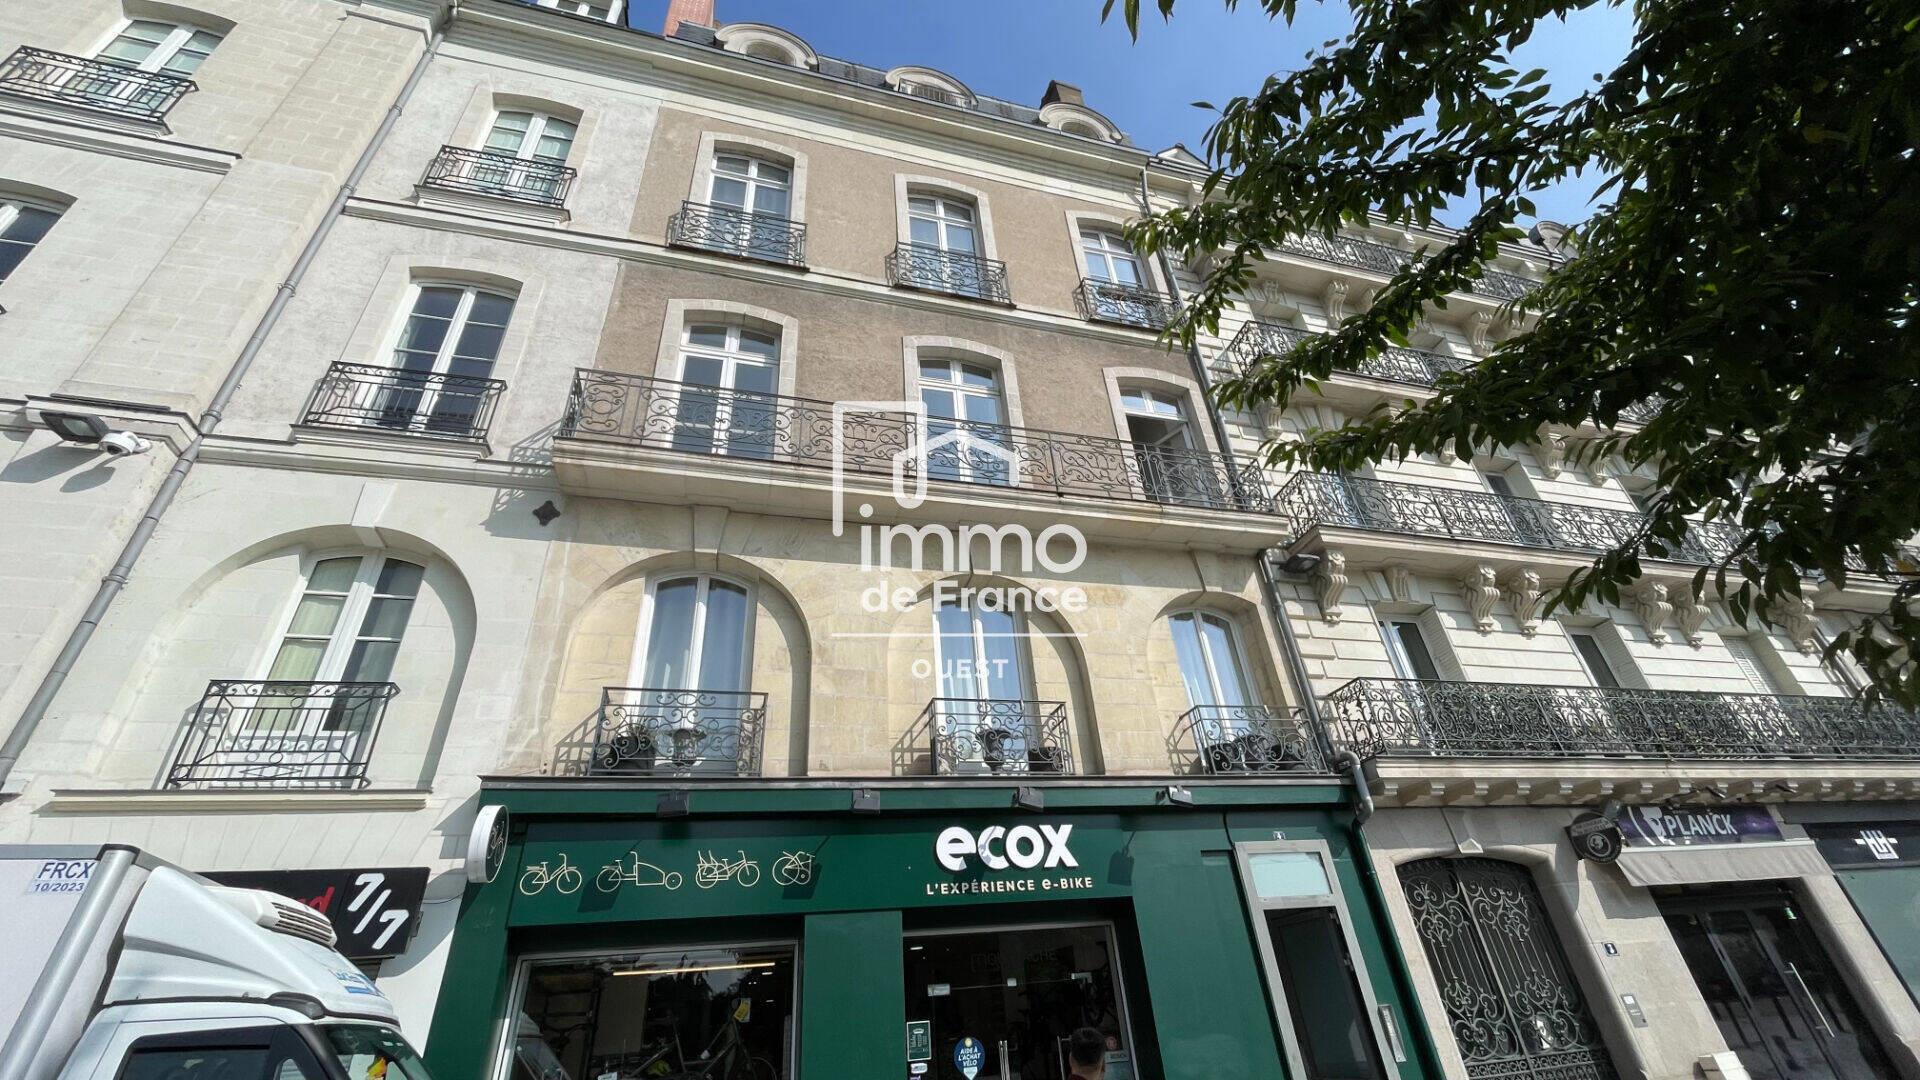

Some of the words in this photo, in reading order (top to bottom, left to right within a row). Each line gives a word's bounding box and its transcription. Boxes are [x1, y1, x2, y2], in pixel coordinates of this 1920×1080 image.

[1663, 813, 1738, 836] PLANCK
[37, 861, 97, 879] FRCX
[34, 882, 86, 892] 10/2023
[926, 878, 1036, 896] L'EXPÉRIENCE
[347, 872, 410, 950] 7/7
